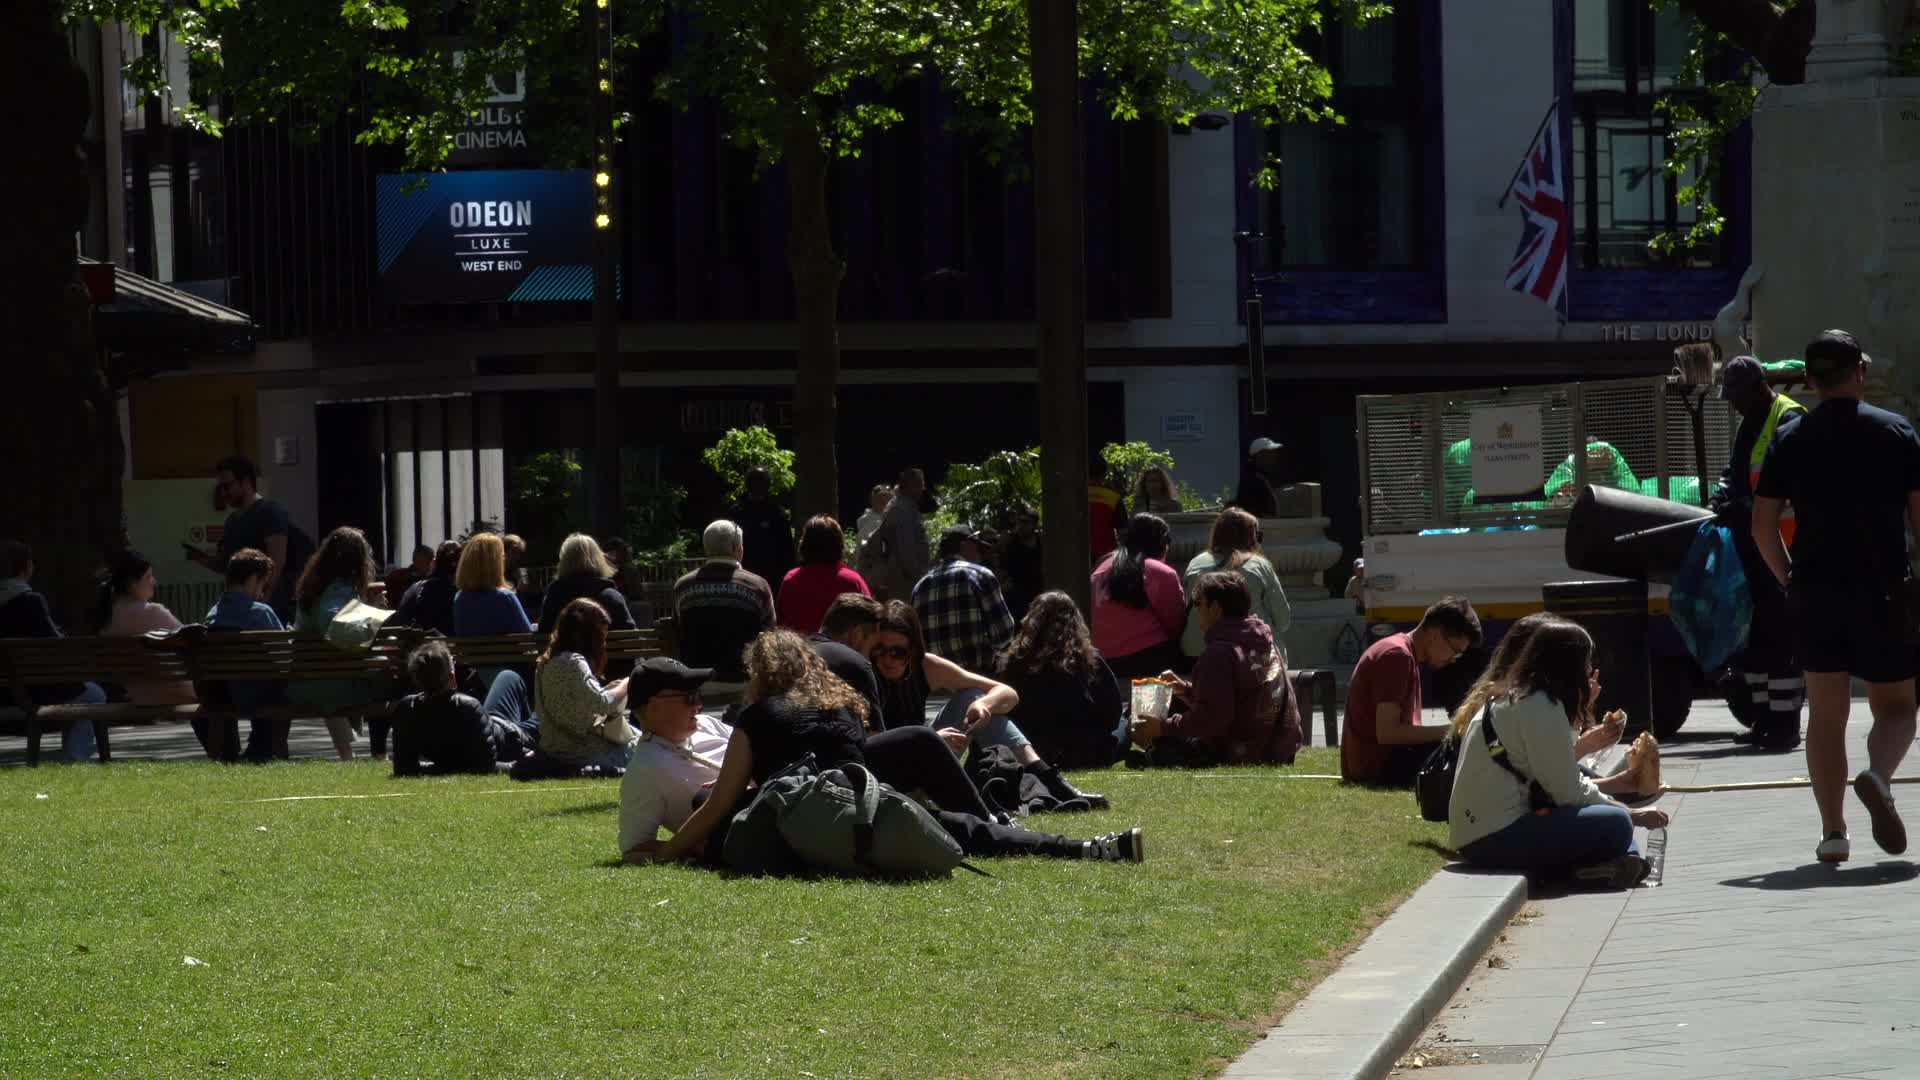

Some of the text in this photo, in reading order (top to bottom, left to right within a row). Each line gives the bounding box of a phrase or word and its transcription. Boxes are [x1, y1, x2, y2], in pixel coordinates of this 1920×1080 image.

[455, 130, 528, 150] CINEMA
[450, 200, 532, 228] ODEON
[471, 239, 511, 250] LUXE
[461, 259, 522, 271] WEST END
[1600, 323, 1641, 342] THE
